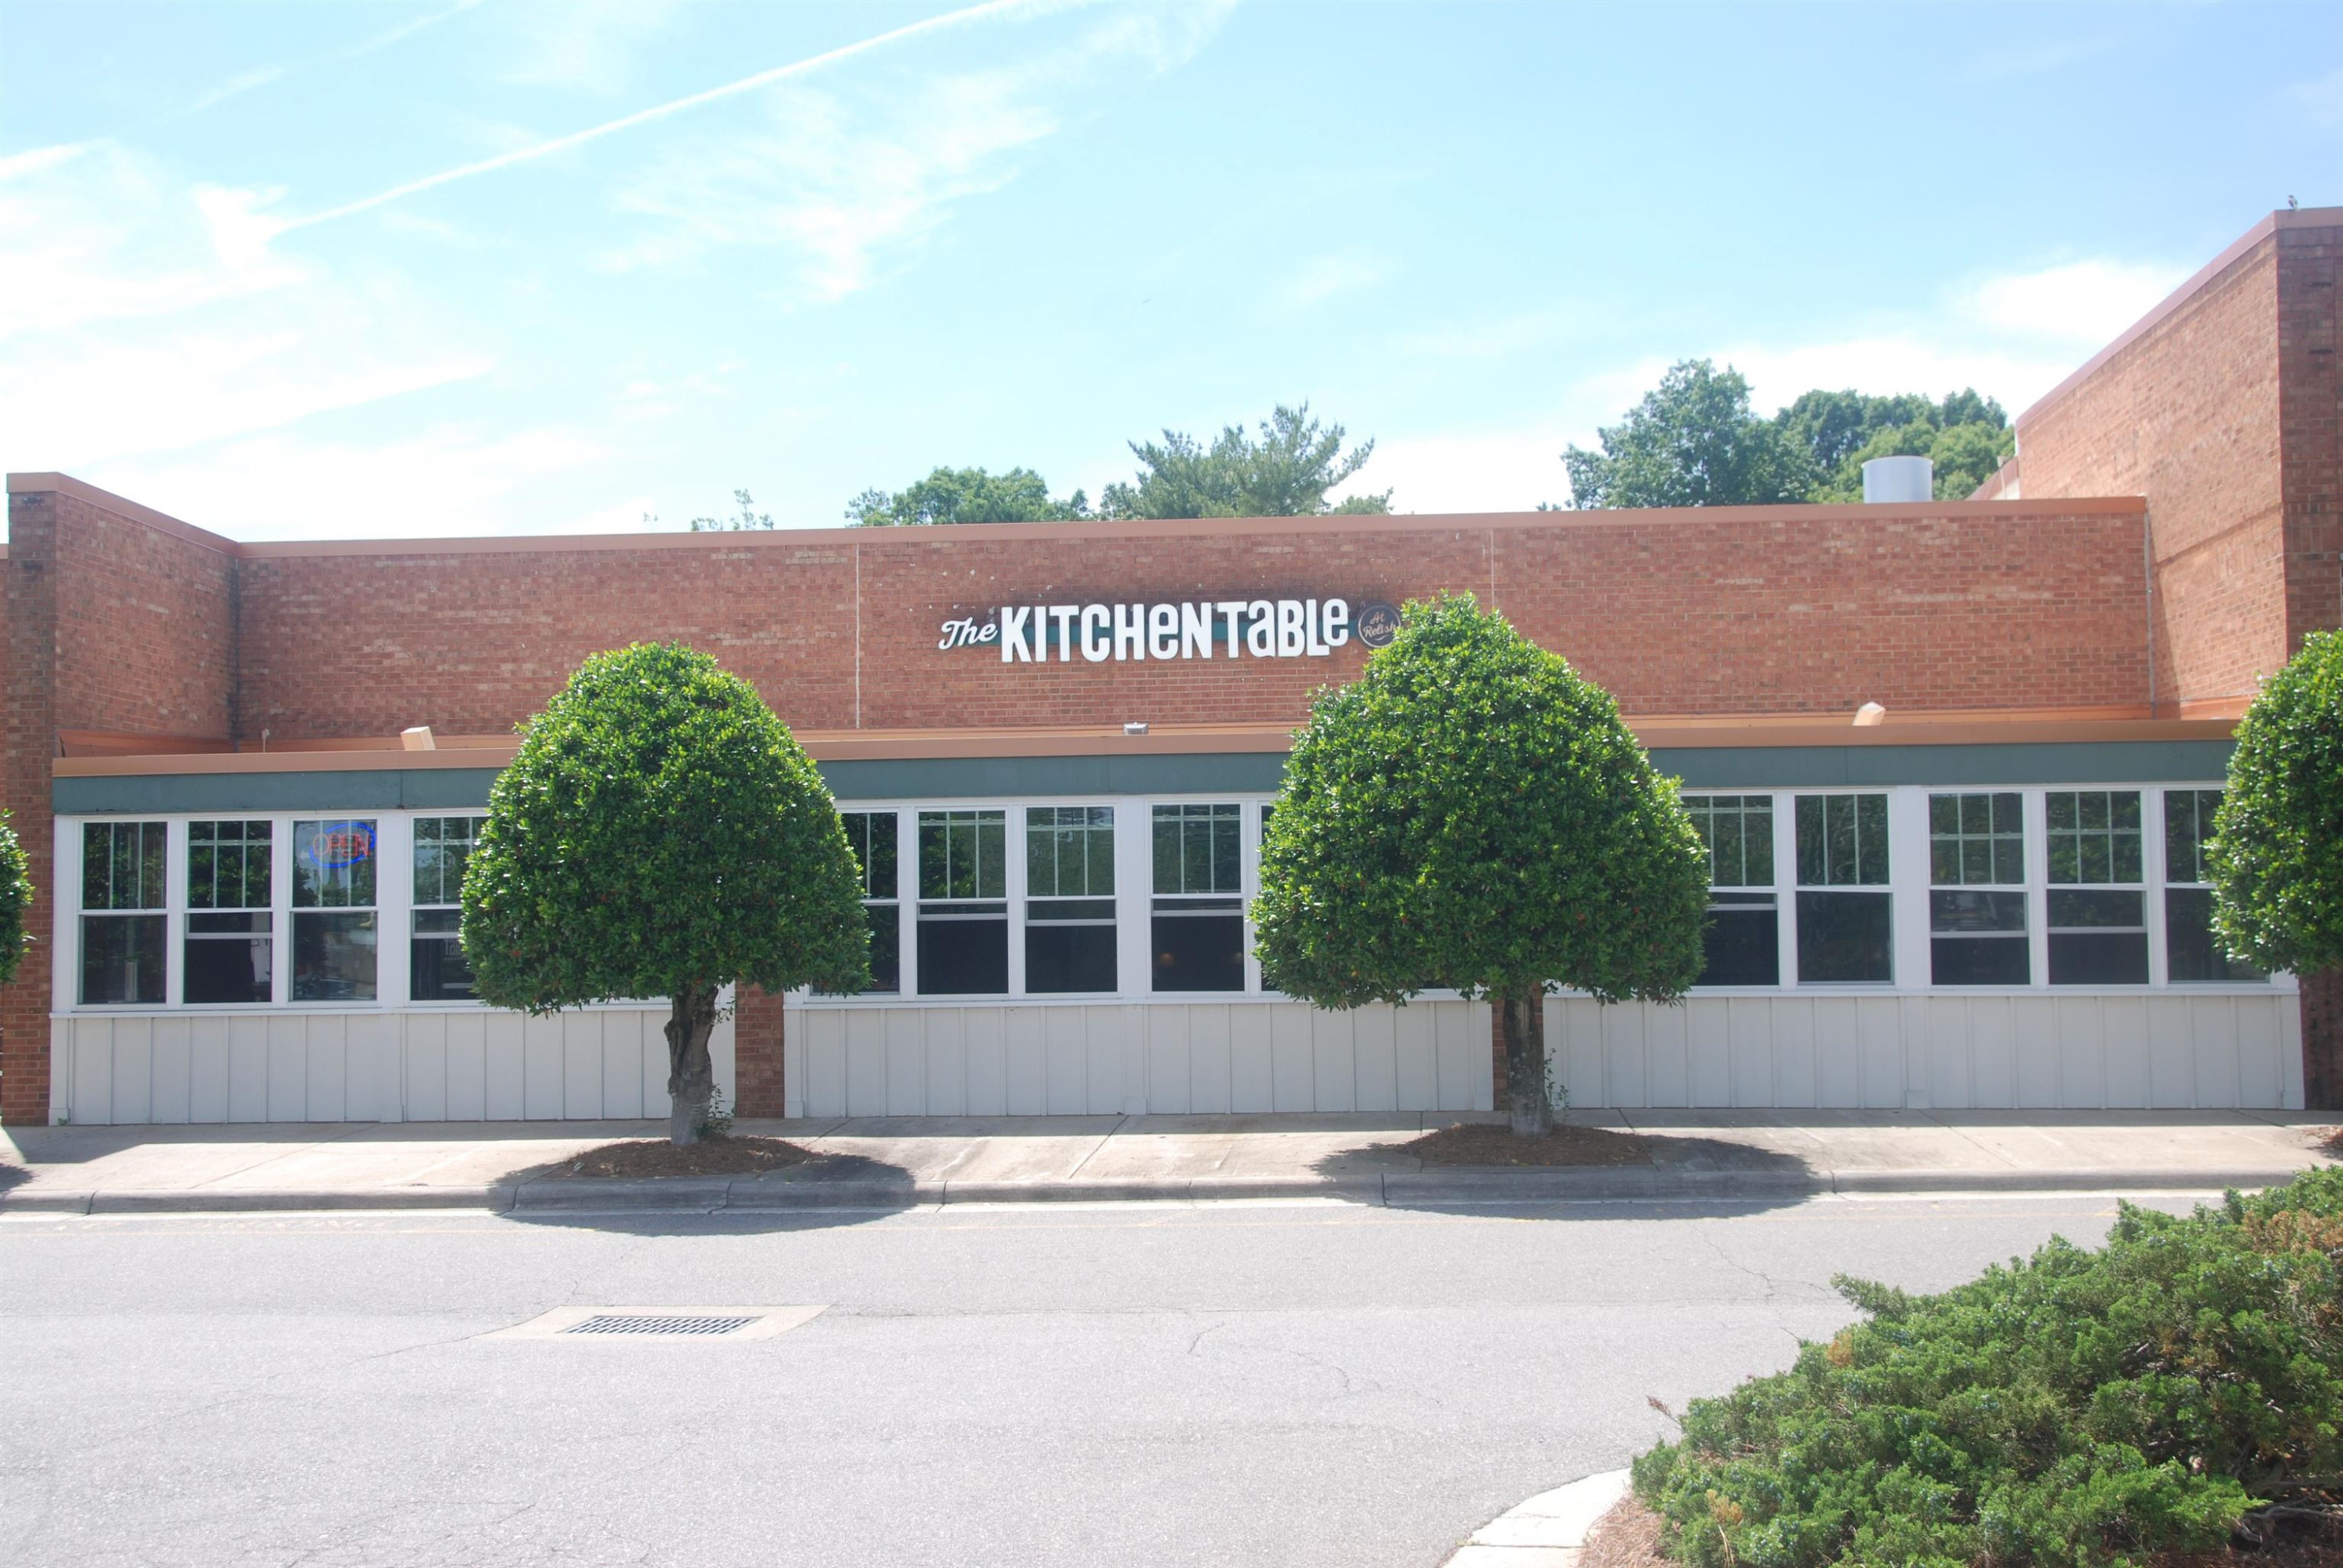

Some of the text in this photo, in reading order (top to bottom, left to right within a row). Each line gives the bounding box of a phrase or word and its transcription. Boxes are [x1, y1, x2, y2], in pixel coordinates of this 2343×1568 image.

[1369, 611, 1385, 625] At
[938, 617, 998, 650] The
[1363, 621, 1396, 637] Relish
[313, 832, 370, 857] OPEN
